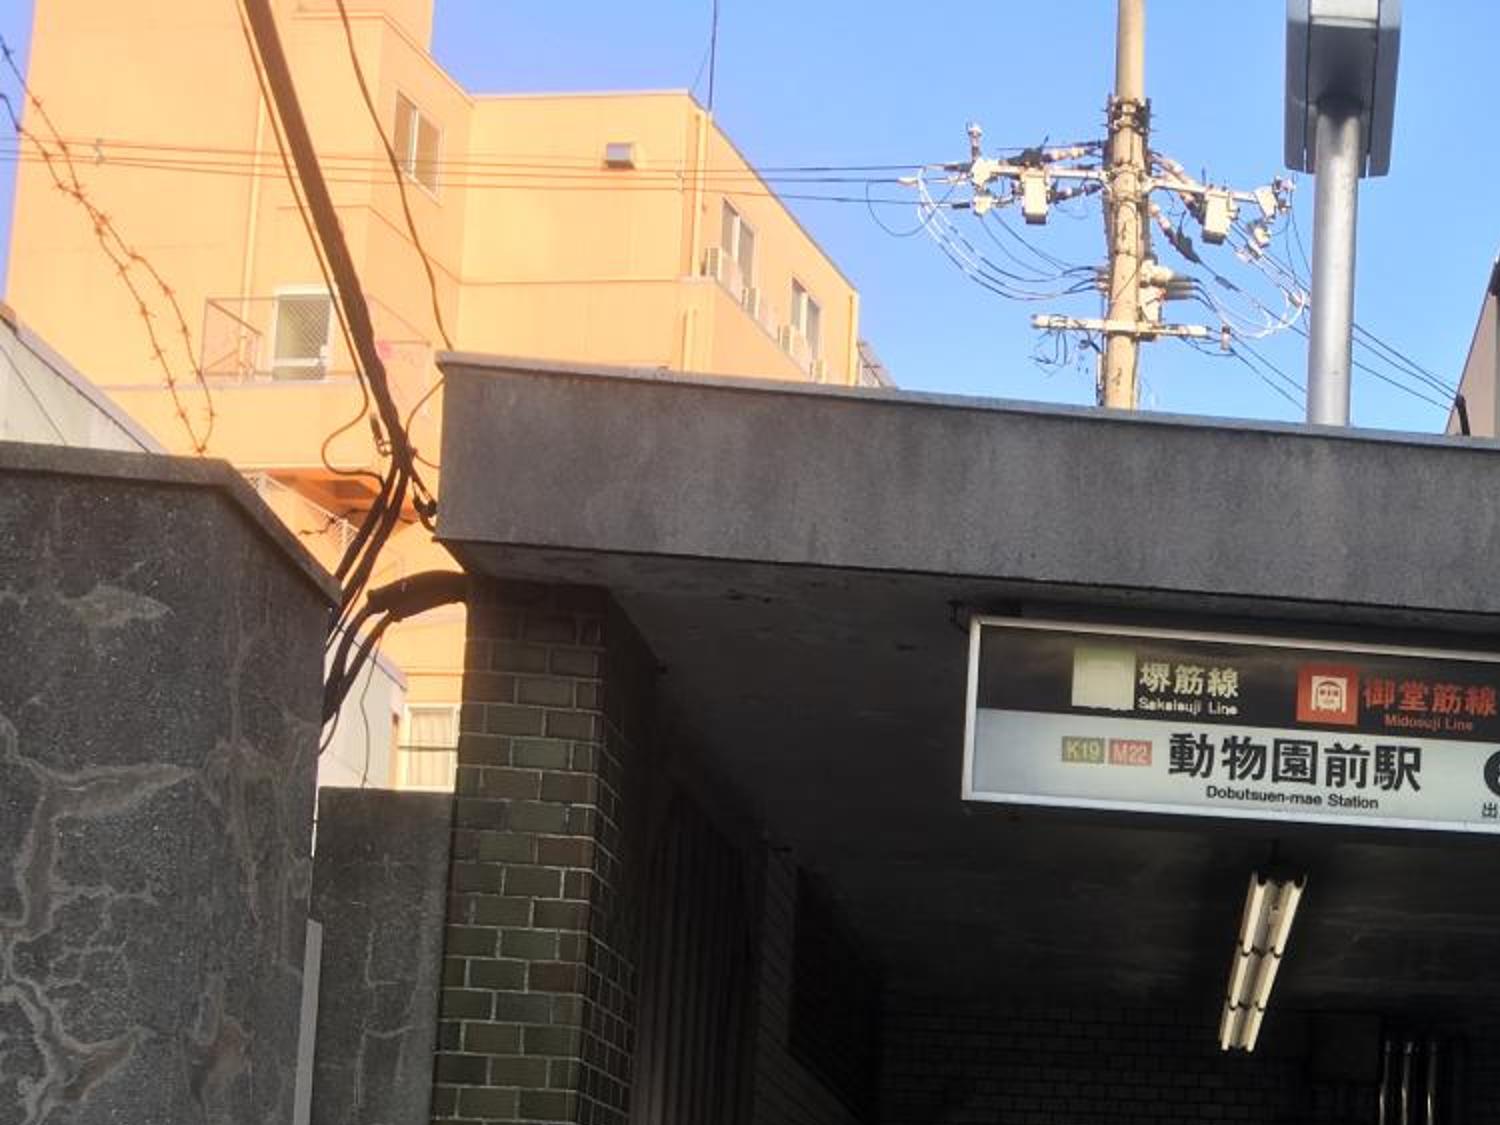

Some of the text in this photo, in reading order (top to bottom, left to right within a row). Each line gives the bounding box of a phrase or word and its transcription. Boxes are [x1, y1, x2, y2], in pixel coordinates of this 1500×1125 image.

[1139, 662, 1240, 699] 堺筋線
[1137, 696, 1238, 716] Sakaisuji Line
[1363, 675, 1498, 718] 御堂筋線
[1384, 712, 1474, 732] Midosuji Line
[1112, 743, 1150, 764] M22
[1167, 732, 1422, 792] 動物園前駅
[1205, 784, 1379, 810] Dobutsuen-mae Station
